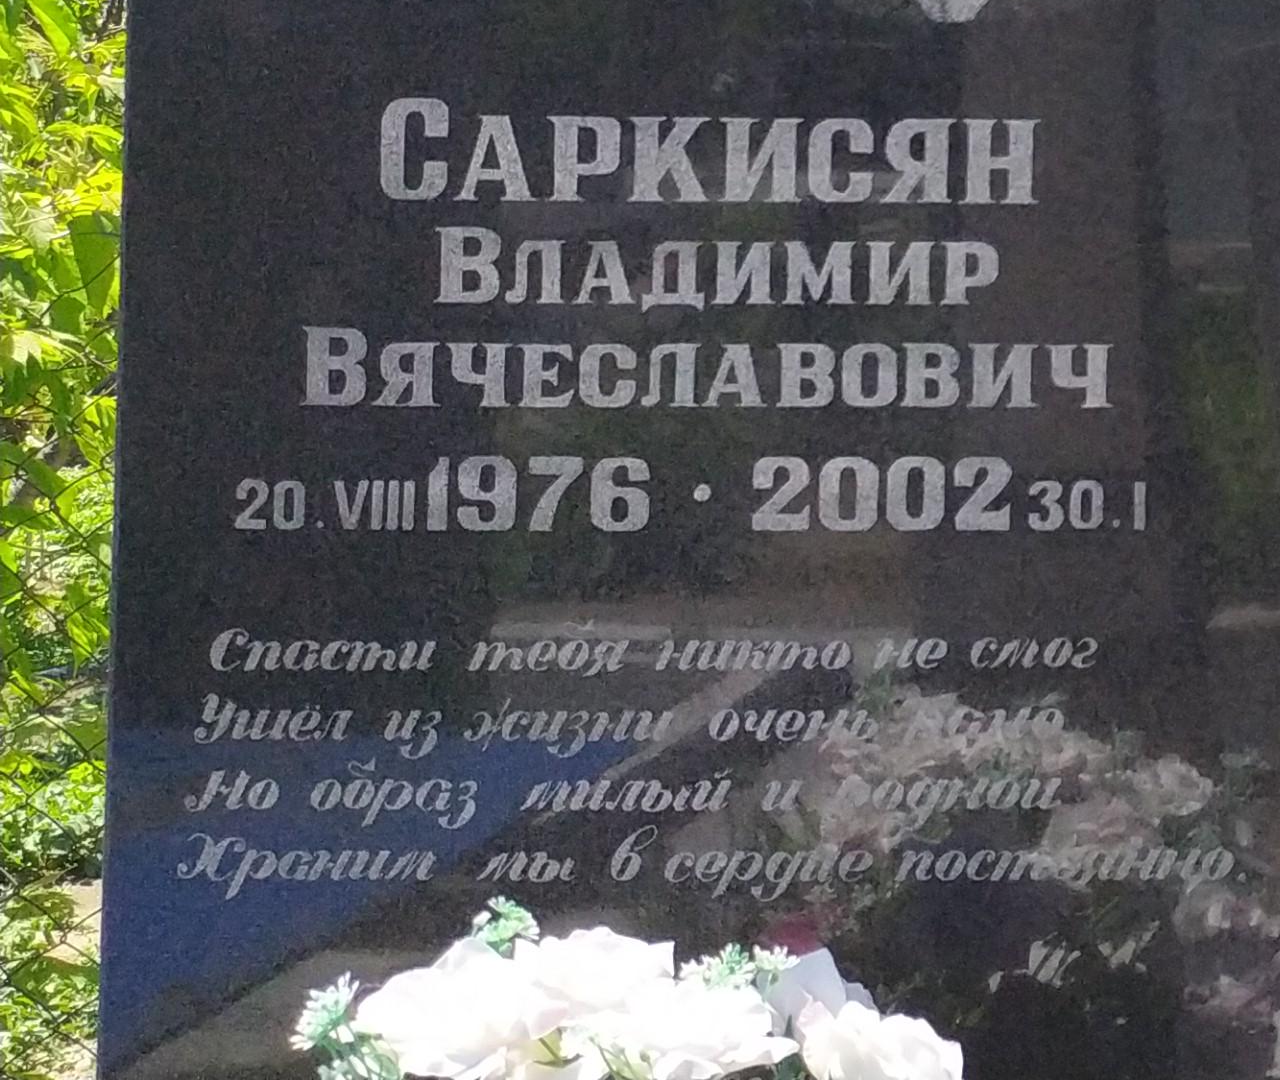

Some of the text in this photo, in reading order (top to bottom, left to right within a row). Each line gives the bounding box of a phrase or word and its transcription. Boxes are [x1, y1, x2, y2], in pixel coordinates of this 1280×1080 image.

[209, 619, 1099, 677] Спасти тебя никто не смог
[194, 692, 354, 744] Ушёл
[383, 709, 442, 760] из
[463, 698, 673, 758] жизни
[708, 708, 879, 743] очень
[183, 770, 280, 813] Но
[310, 757, 478, 830] образ
[519, 768, 732, 813] милый
[761, 779, 803, 813] и
[177, 833, 437, 901] Храним
[476, 851, 575, 883] мы
[610, 825, 658, 882] в
[664, 850, 874, 902] сердце
